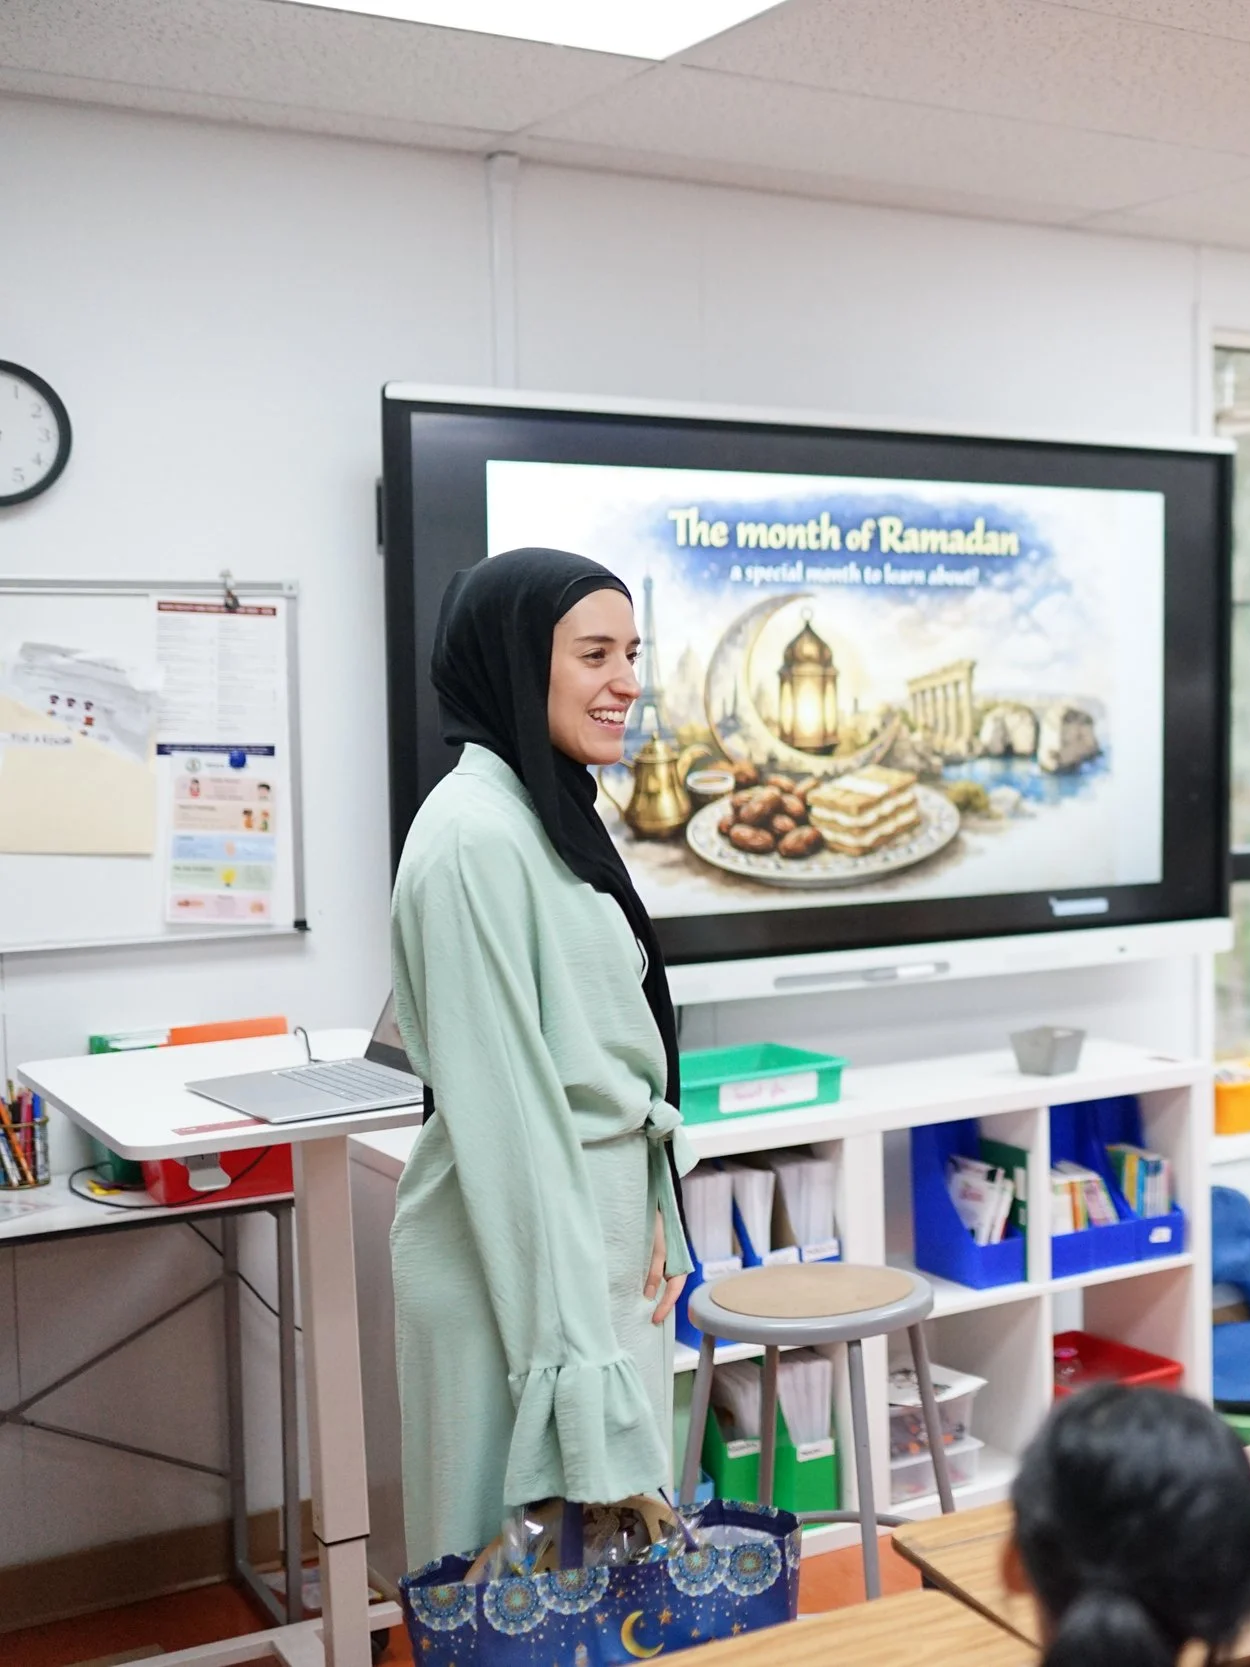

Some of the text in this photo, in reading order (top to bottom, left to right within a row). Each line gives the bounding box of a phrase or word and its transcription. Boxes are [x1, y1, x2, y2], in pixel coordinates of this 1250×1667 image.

[30, 402, 42, 419] 2
[37, 426, 51, 444] 3
[31, 451, 42, 467] 4
[12, 466, 25, 484] 5
[667, 506, 1020, 556] The month of Ramadan
[729, 564, 743, 583] a
[744, 559, 804, 588] special
[805, 561, 862, 585] month
[863, 565, 883, 586] to
[883, 562, 927, 586] learn
